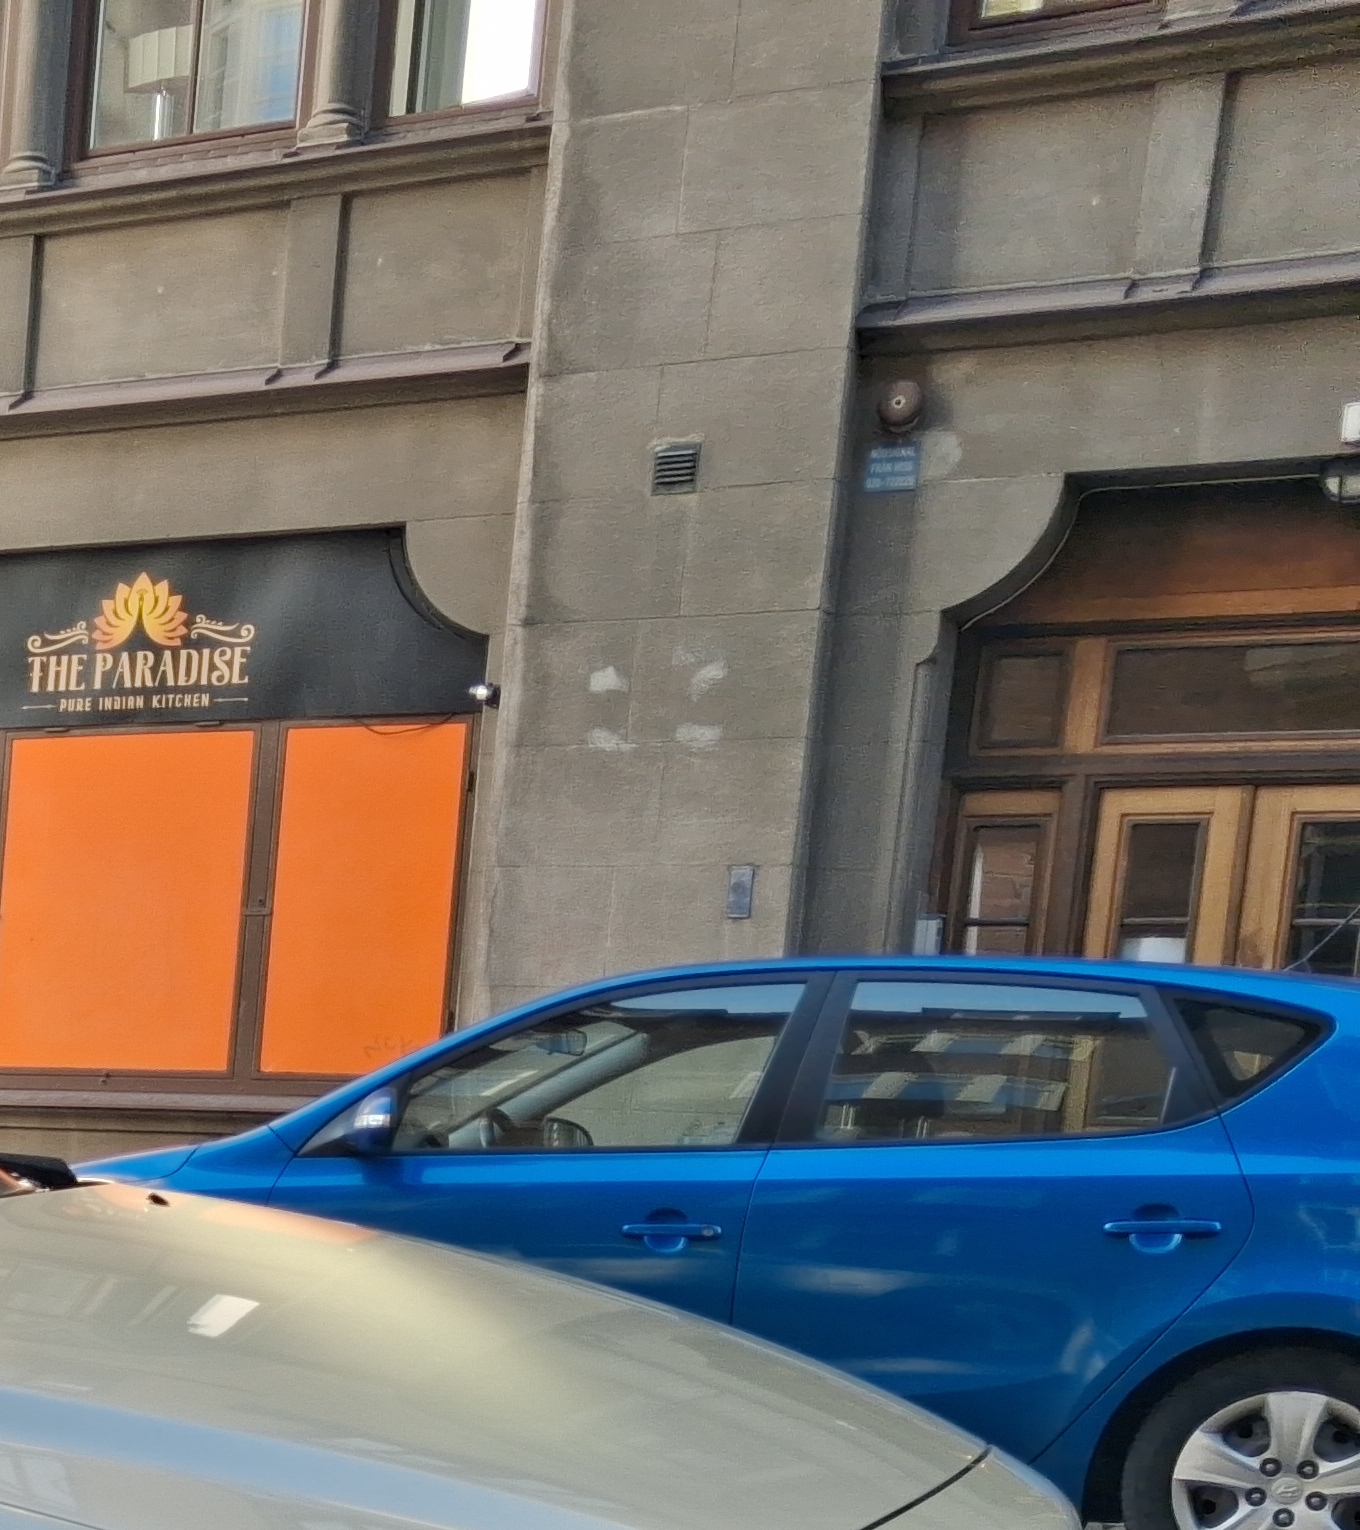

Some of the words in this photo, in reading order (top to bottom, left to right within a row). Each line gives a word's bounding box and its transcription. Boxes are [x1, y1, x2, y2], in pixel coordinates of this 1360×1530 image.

[28, 654, 87, 693] THE
[93, 646, 251, 690] PARADISE
[59, 697, 92, 712] PURE
[99, 695, 145, 710] INDIAN
[152, 693, 210, 709] KITCHEN
